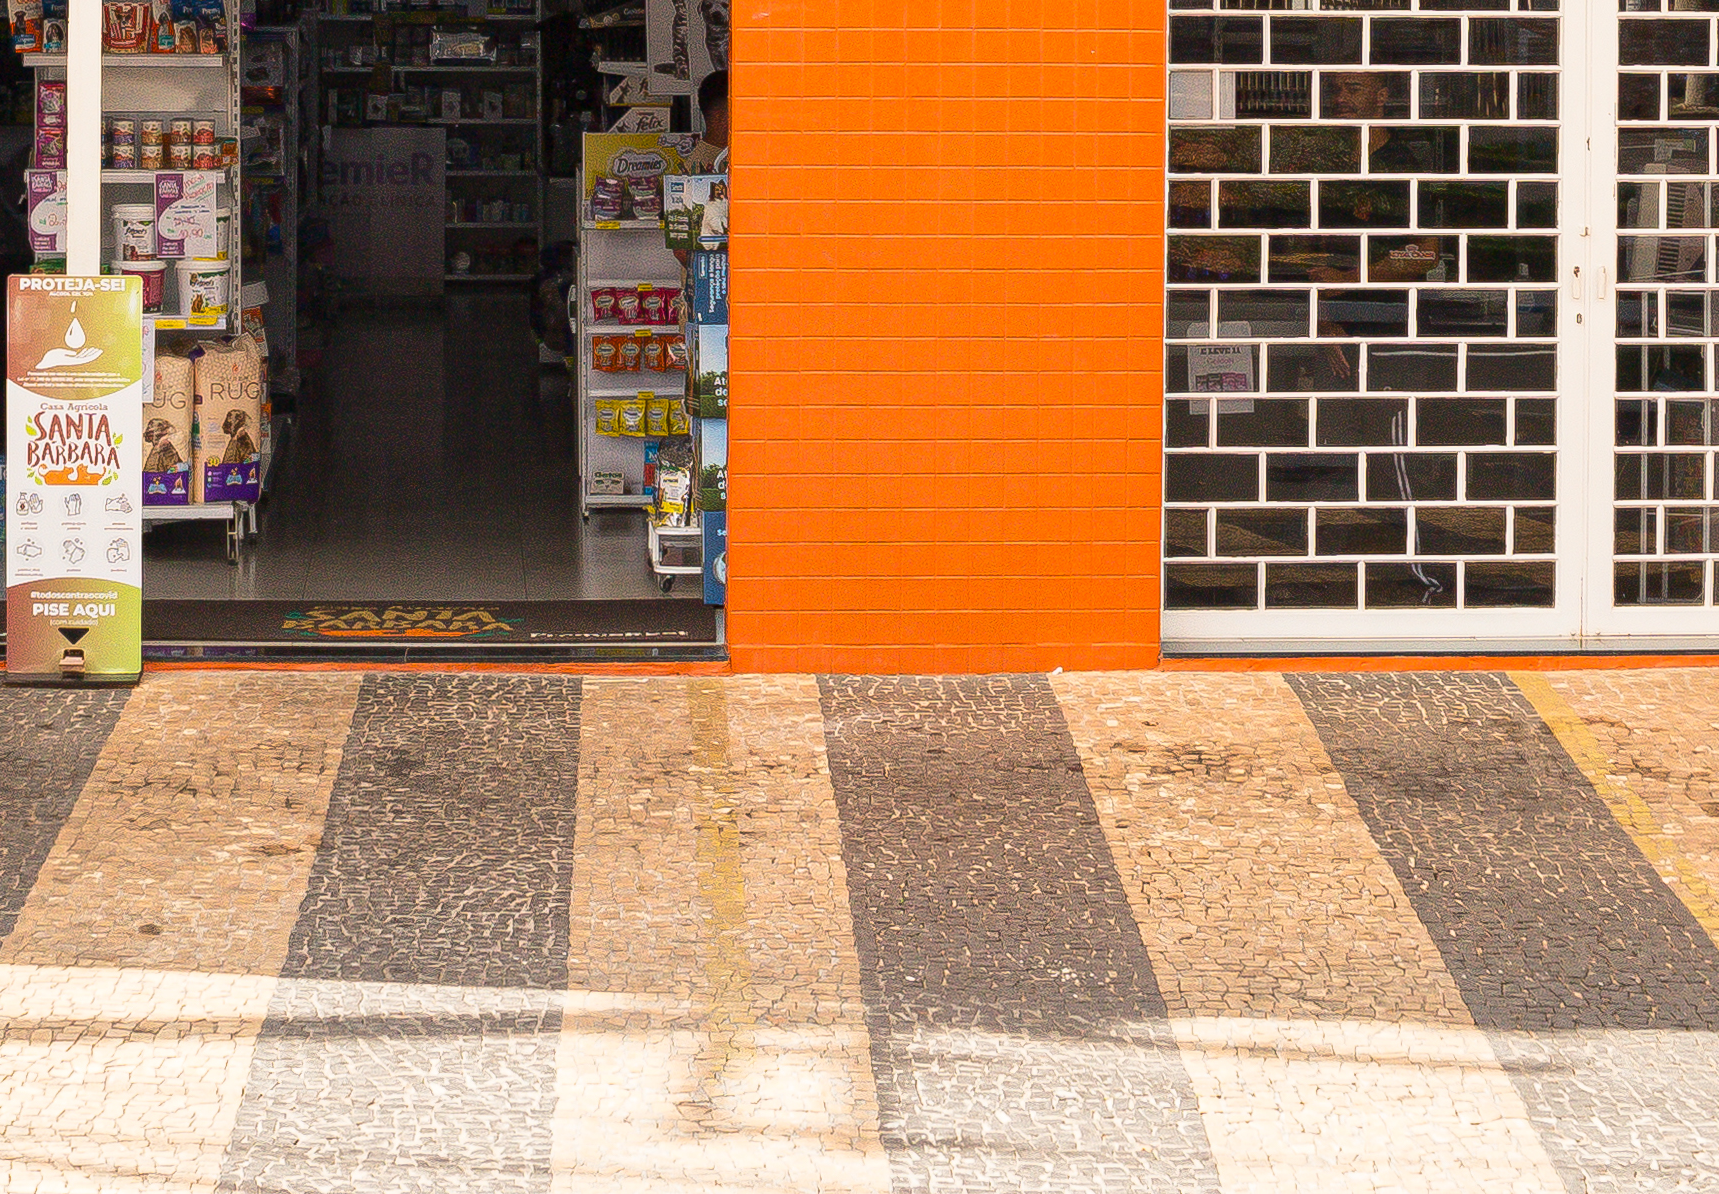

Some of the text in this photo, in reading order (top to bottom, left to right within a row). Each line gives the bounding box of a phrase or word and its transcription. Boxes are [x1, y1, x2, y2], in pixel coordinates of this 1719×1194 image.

[616, 156, 664, 173] Dreamies
[19, 277, 126, 291] PROTEJA-SE!
[40, 402, 109, 412] Casa Agrícola
[33, 411, 112, 446] SANTA
[27, 440, 120, 469] BÁRBARA
[33, 603, 116, 618] PISE AQUI
